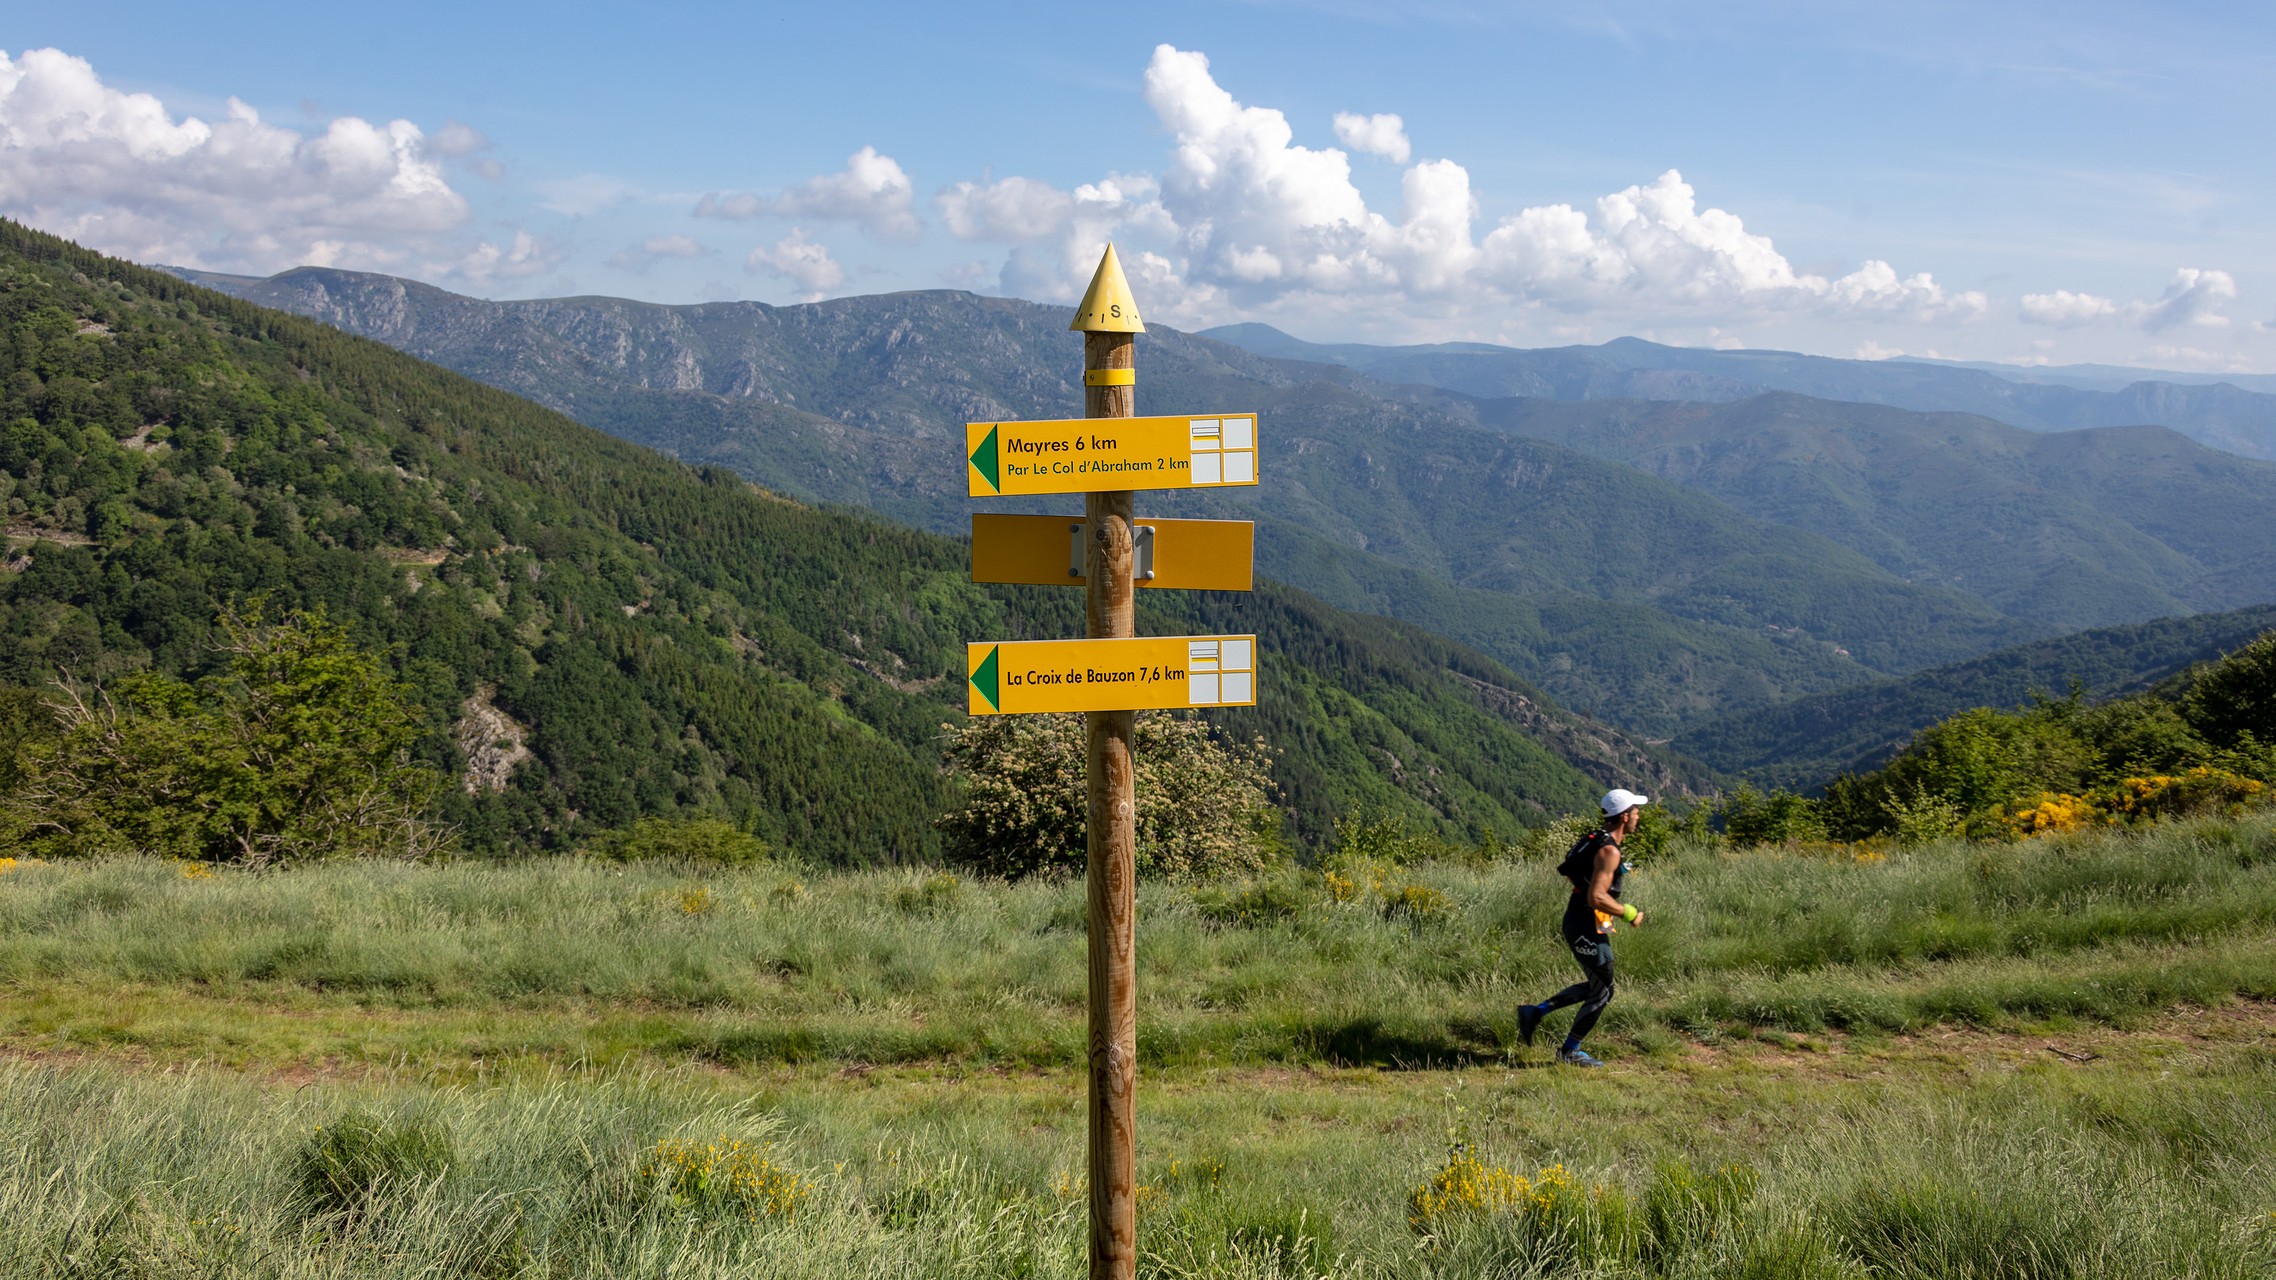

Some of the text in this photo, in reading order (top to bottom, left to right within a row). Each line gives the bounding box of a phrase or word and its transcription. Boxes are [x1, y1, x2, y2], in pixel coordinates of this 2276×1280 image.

[1110, 304, 1121, 318] S
[1007, 434, 1117, 457] Mayres 6 km
[1007, 456, 1189, 476] Par Le Col d'Abraham 2 km
[1007, 665, 1185, 686] La Croix de Bauzon 7,6 km
